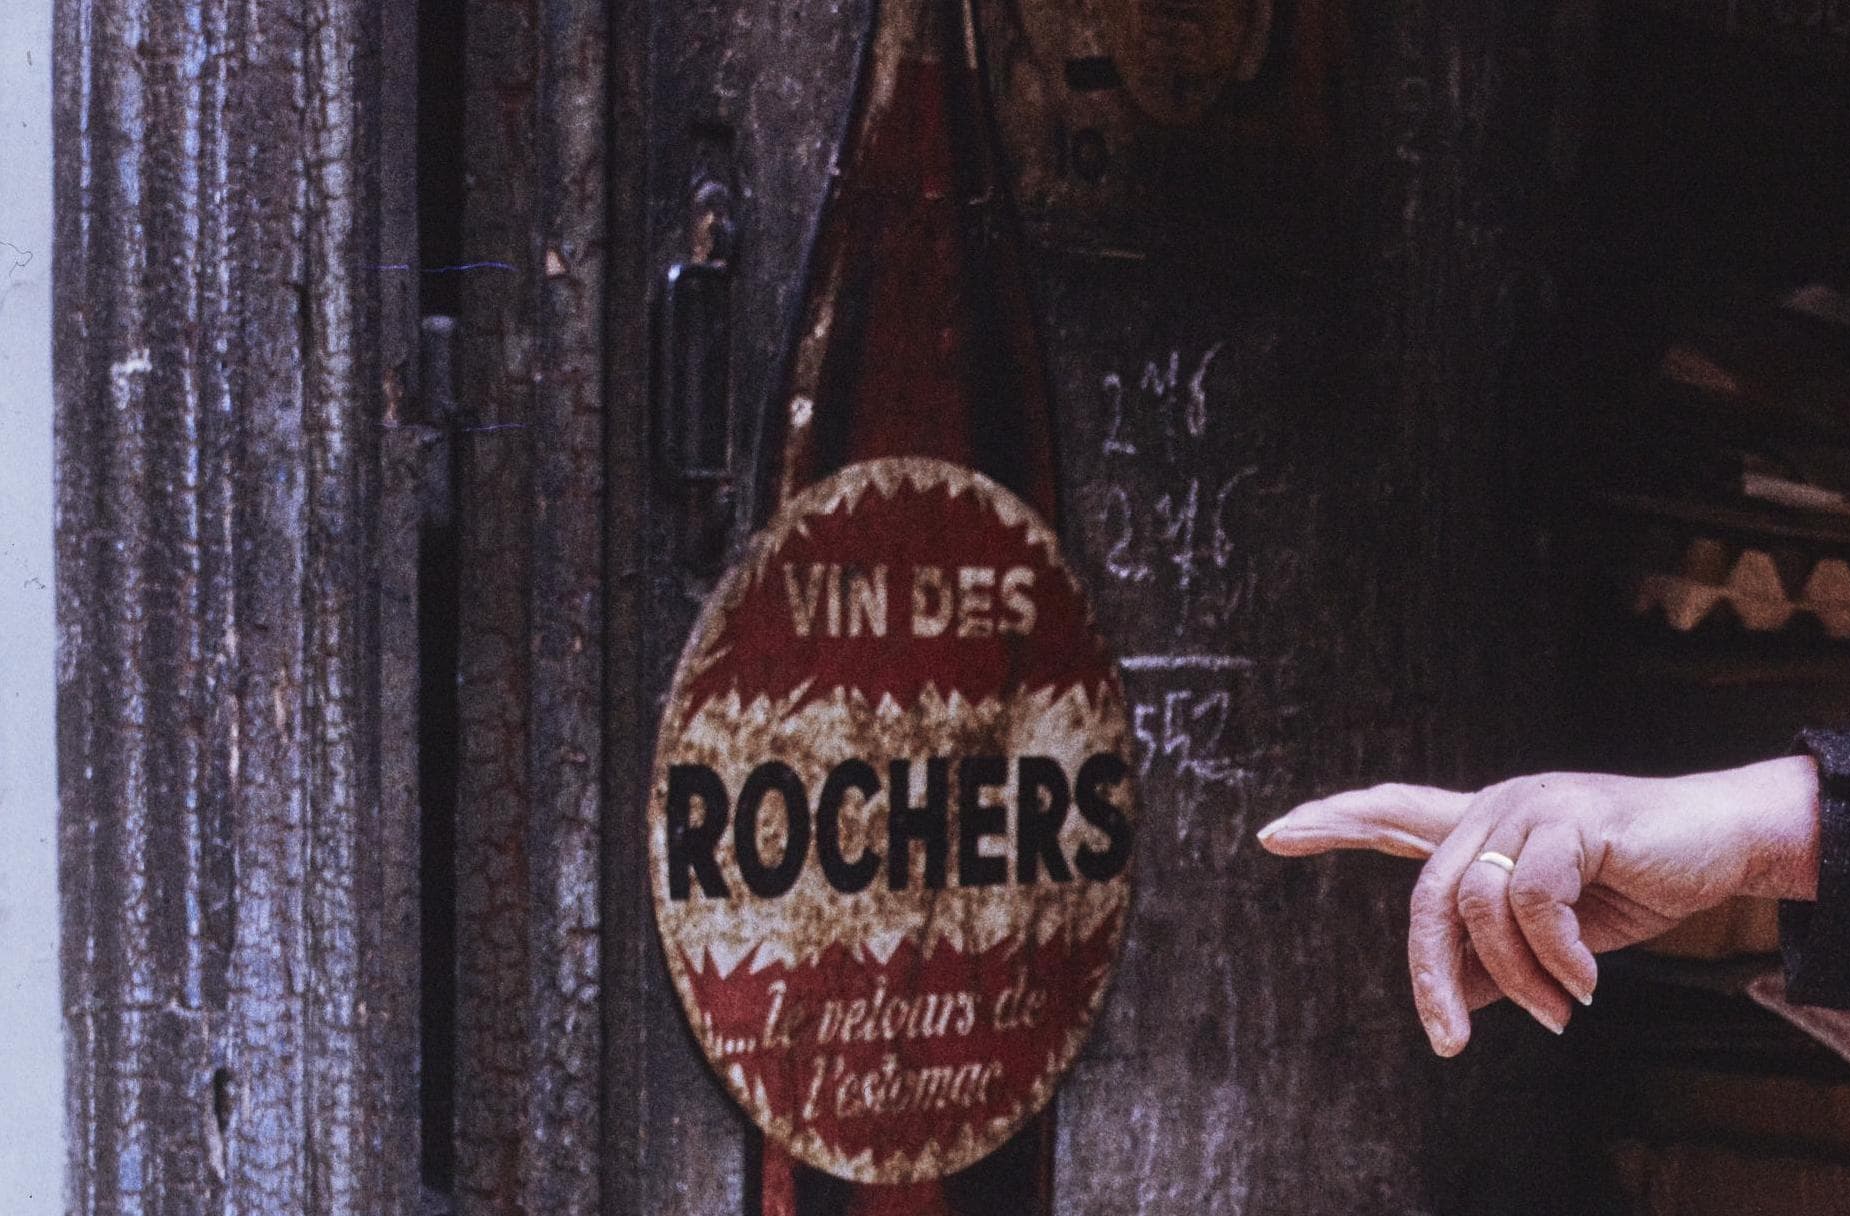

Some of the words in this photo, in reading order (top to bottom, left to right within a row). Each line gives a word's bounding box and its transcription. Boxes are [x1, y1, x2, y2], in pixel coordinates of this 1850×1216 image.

[783, 563, 890, 639] VIN
[911, 565, 1038, 639] DES
[668, 752, 1134, 901] ROCHERS
[816, 973, 978, 1043] velours
[994, 966, 1049, 1031] de
